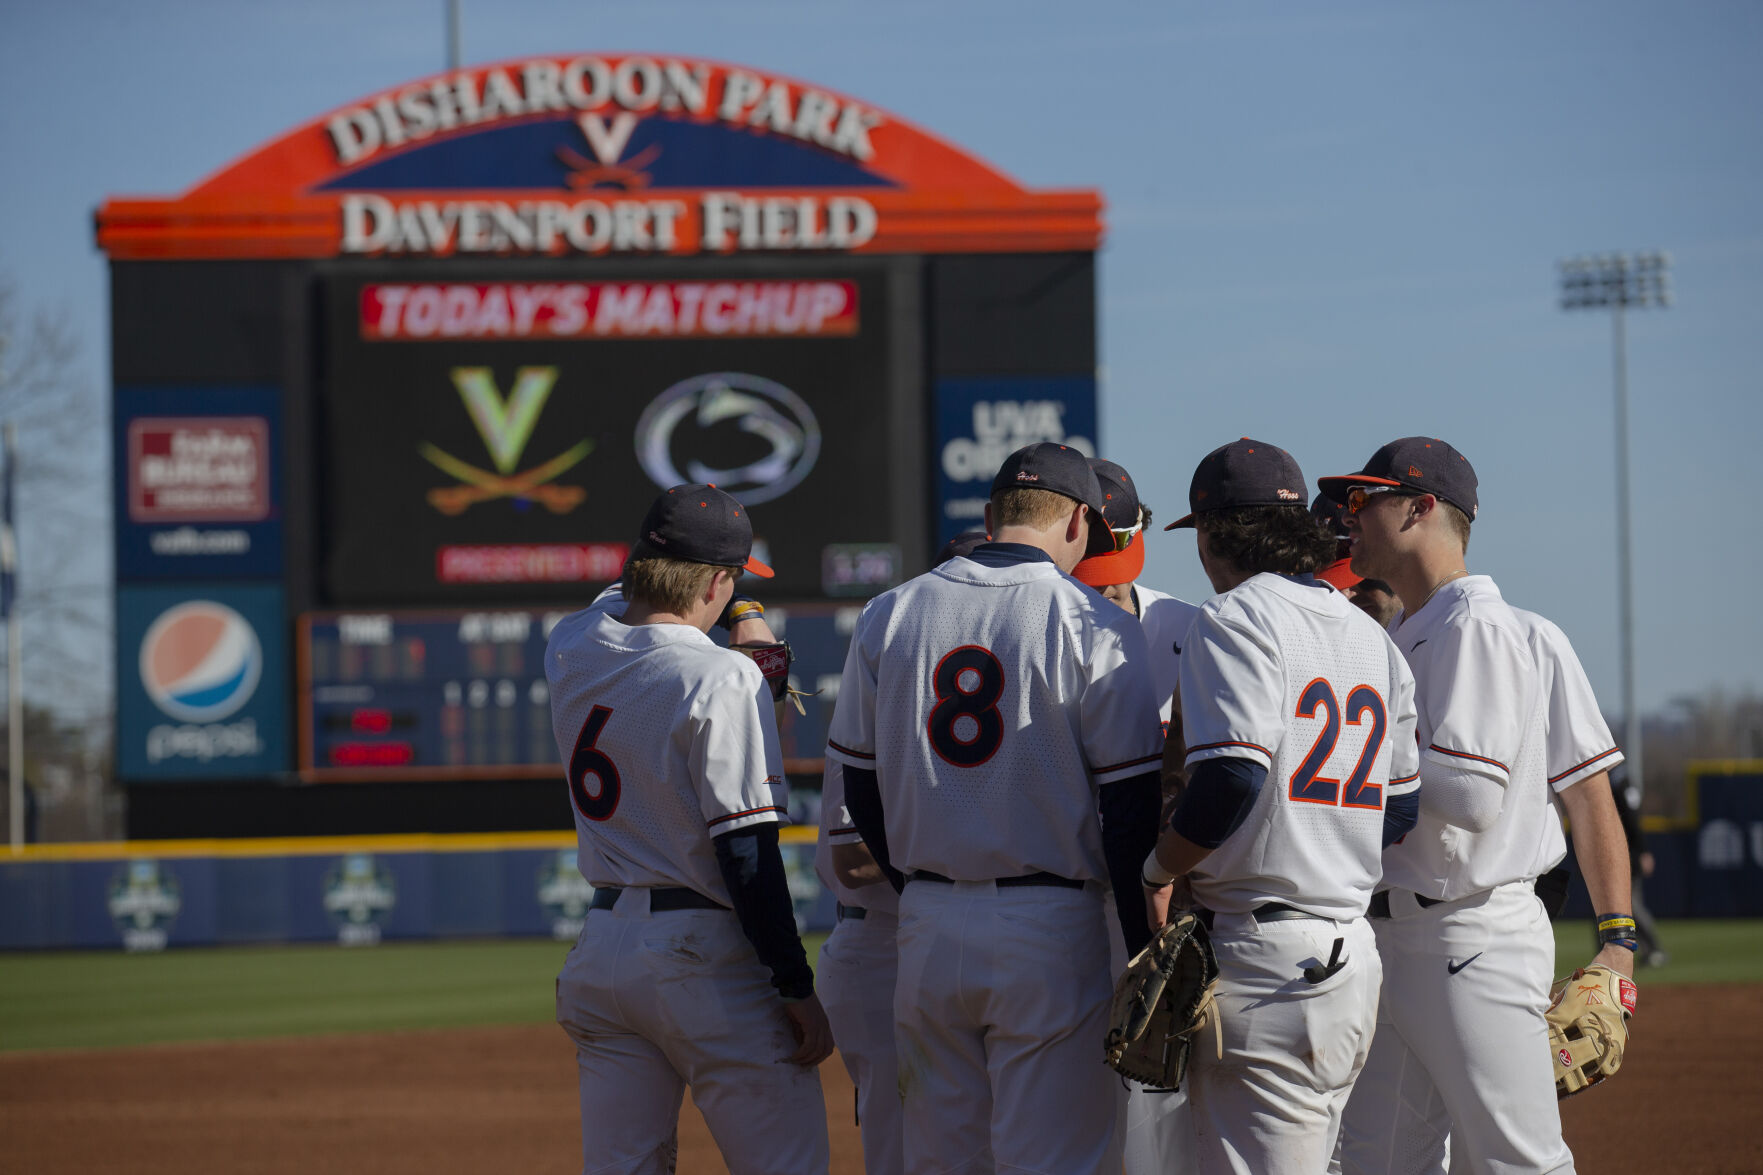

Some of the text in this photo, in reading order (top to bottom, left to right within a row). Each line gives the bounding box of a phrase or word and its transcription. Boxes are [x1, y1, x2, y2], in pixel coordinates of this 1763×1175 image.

[327, 56, 882, 166] DISHAROON PARK
[342, 190, 878, 252] DAVENPORT FIELD
[375, 282, 848, 337] TODAY'S MATCHUP
[146, 717, 261, 765] pepsi
[928, 644, 1005, 768] 8
[1288, 676, 1387, 811] 22
[569, 703, 621, 822] 6
